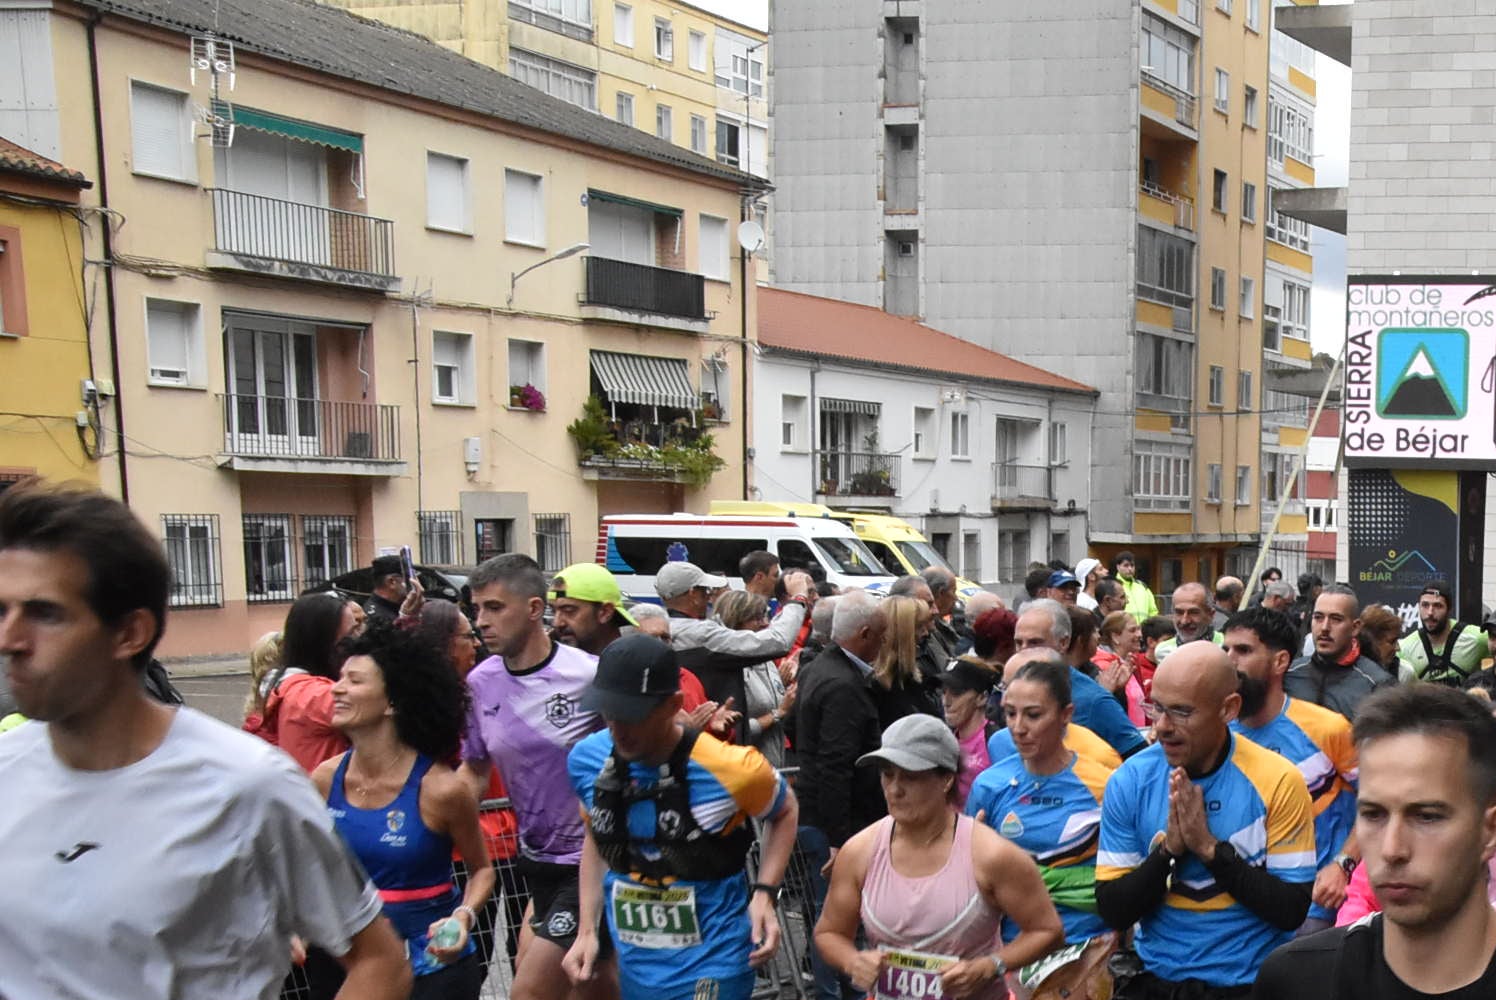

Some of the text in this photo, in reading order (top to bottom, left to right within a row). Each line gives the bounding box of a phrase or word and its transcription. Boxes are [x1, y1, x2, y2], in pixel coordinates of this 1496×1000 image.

[1349, 284, 1442, 305] club de
[1348, 306, 1494, 327] montañeros
[1347, 329, 1373, 424] SIERRA
[1346, 426, 1469, 458] de Béjar
[620, 901, 682, 930] 1161
[887, 966, 944, 1000] 1404
